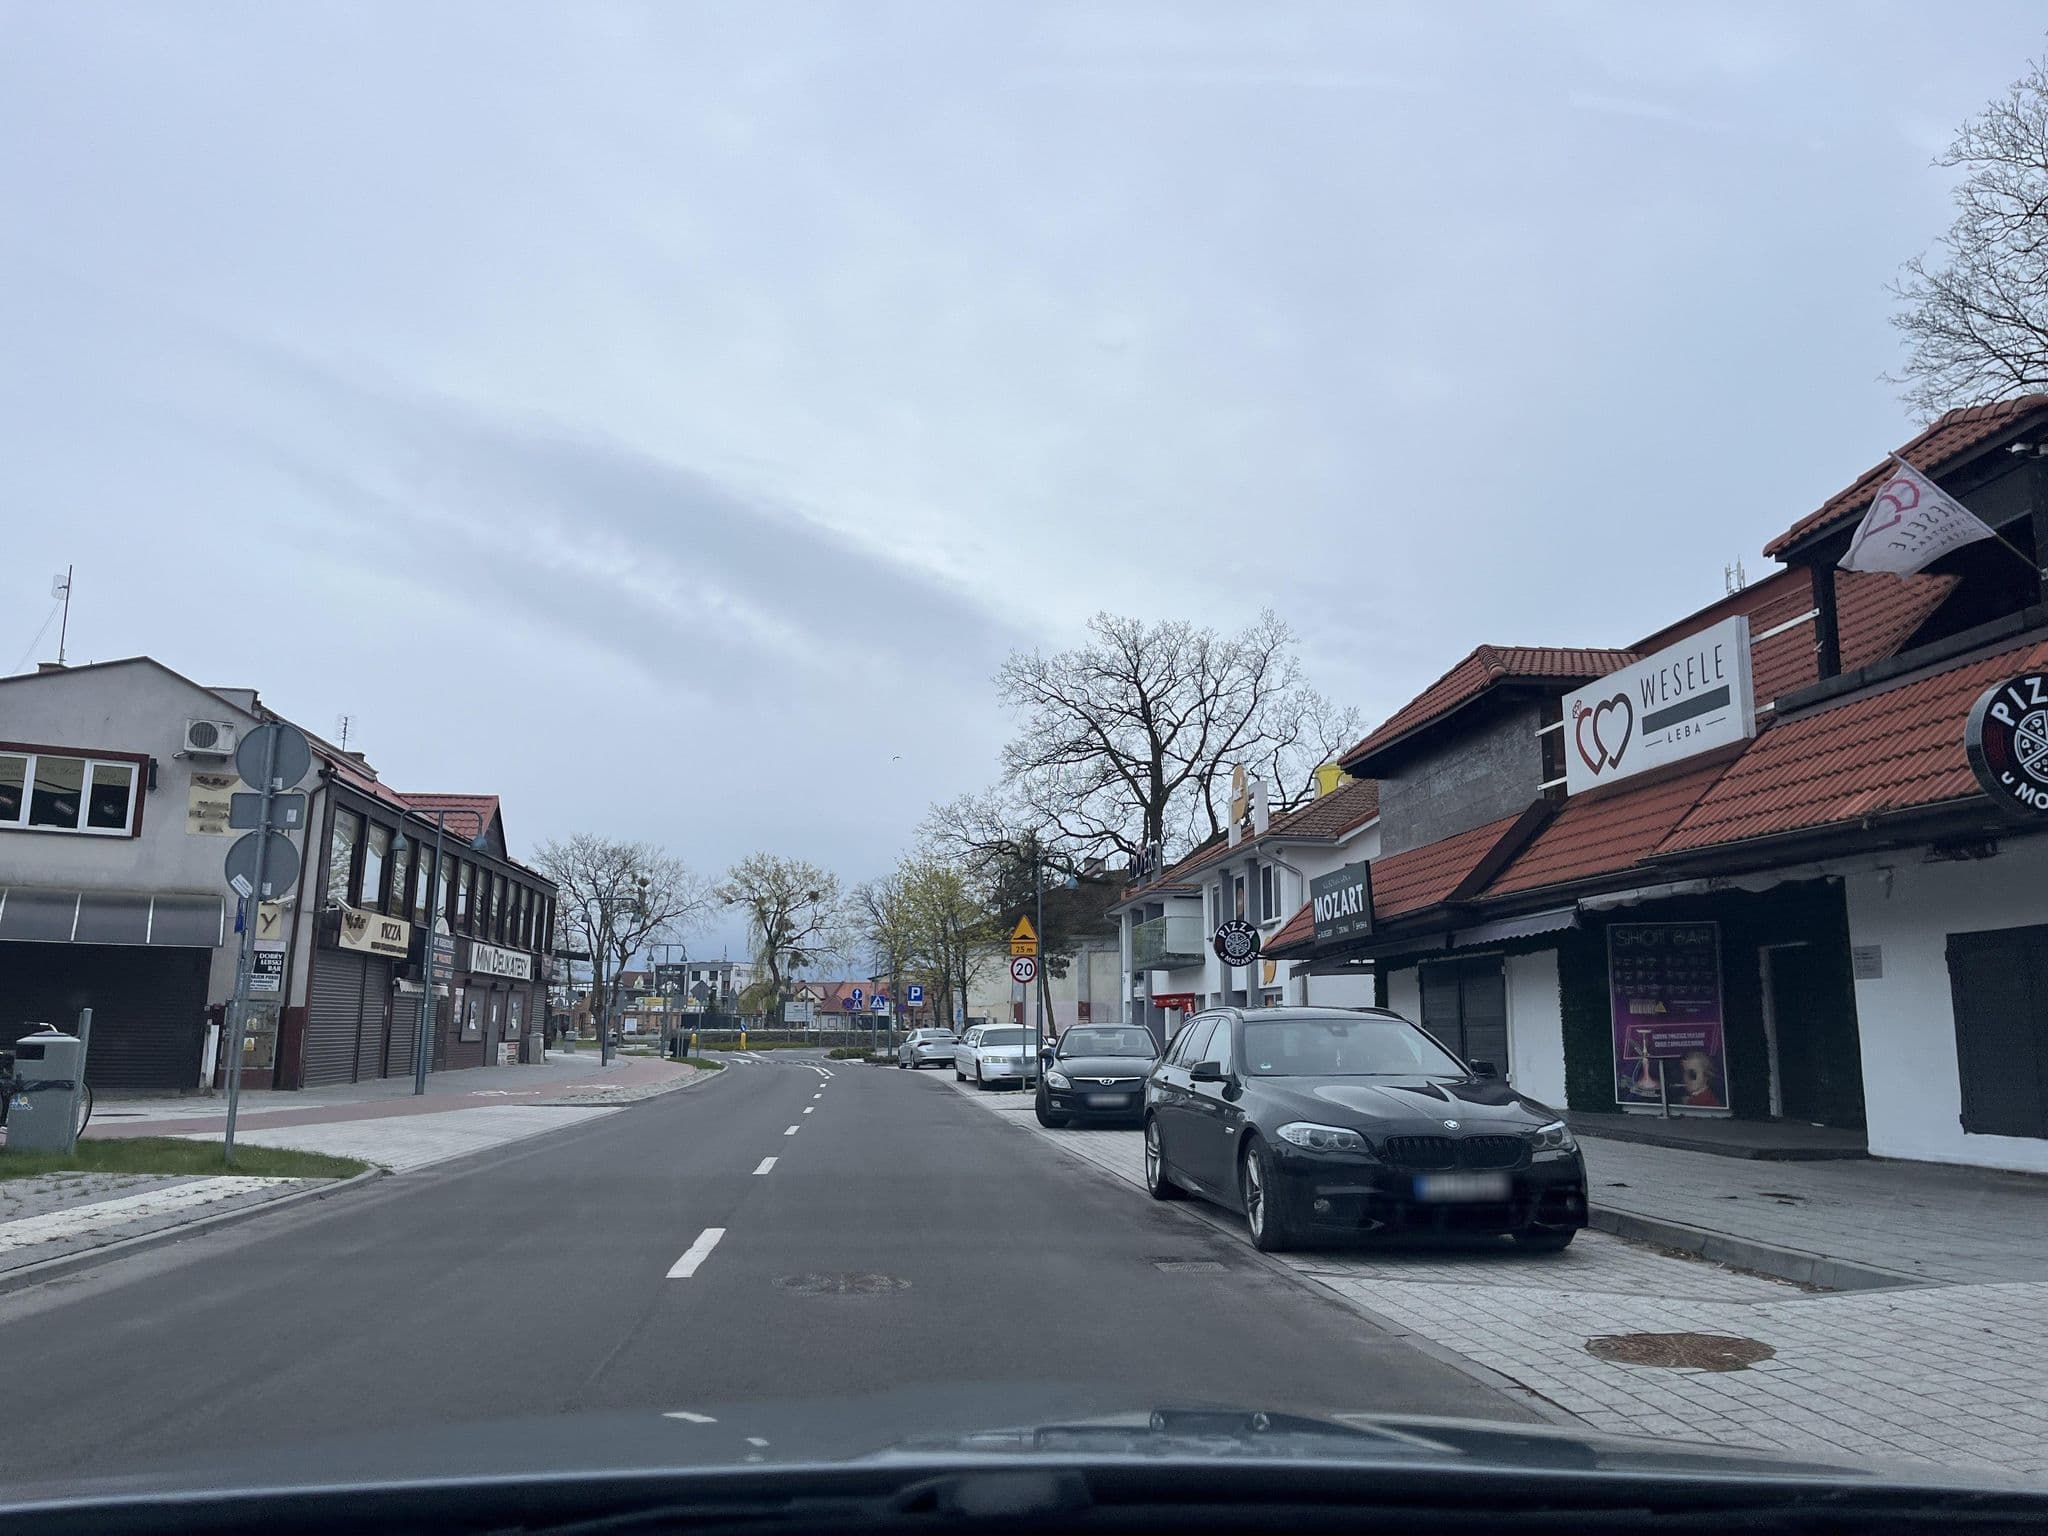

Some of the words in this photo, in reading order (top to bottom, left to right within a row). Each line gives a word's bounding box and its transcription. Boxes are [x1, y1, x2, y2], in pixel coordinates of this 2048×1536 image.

[1640, 644, 1724, 709] WESELE
[1667, 722, 1702, 743] ŁEBA
[1314, 884, 1363, 923] MOZART
[381, 922, 402, 942] PIZZA
[1218, 921, 1256, 939] PIZZA
[1015, 945, 1025, 953] 25
[1224, 951, 1257, 966] MOZARTA
[1015, 962, 1034, 977] 20
[911, 987, 921, 999] P
